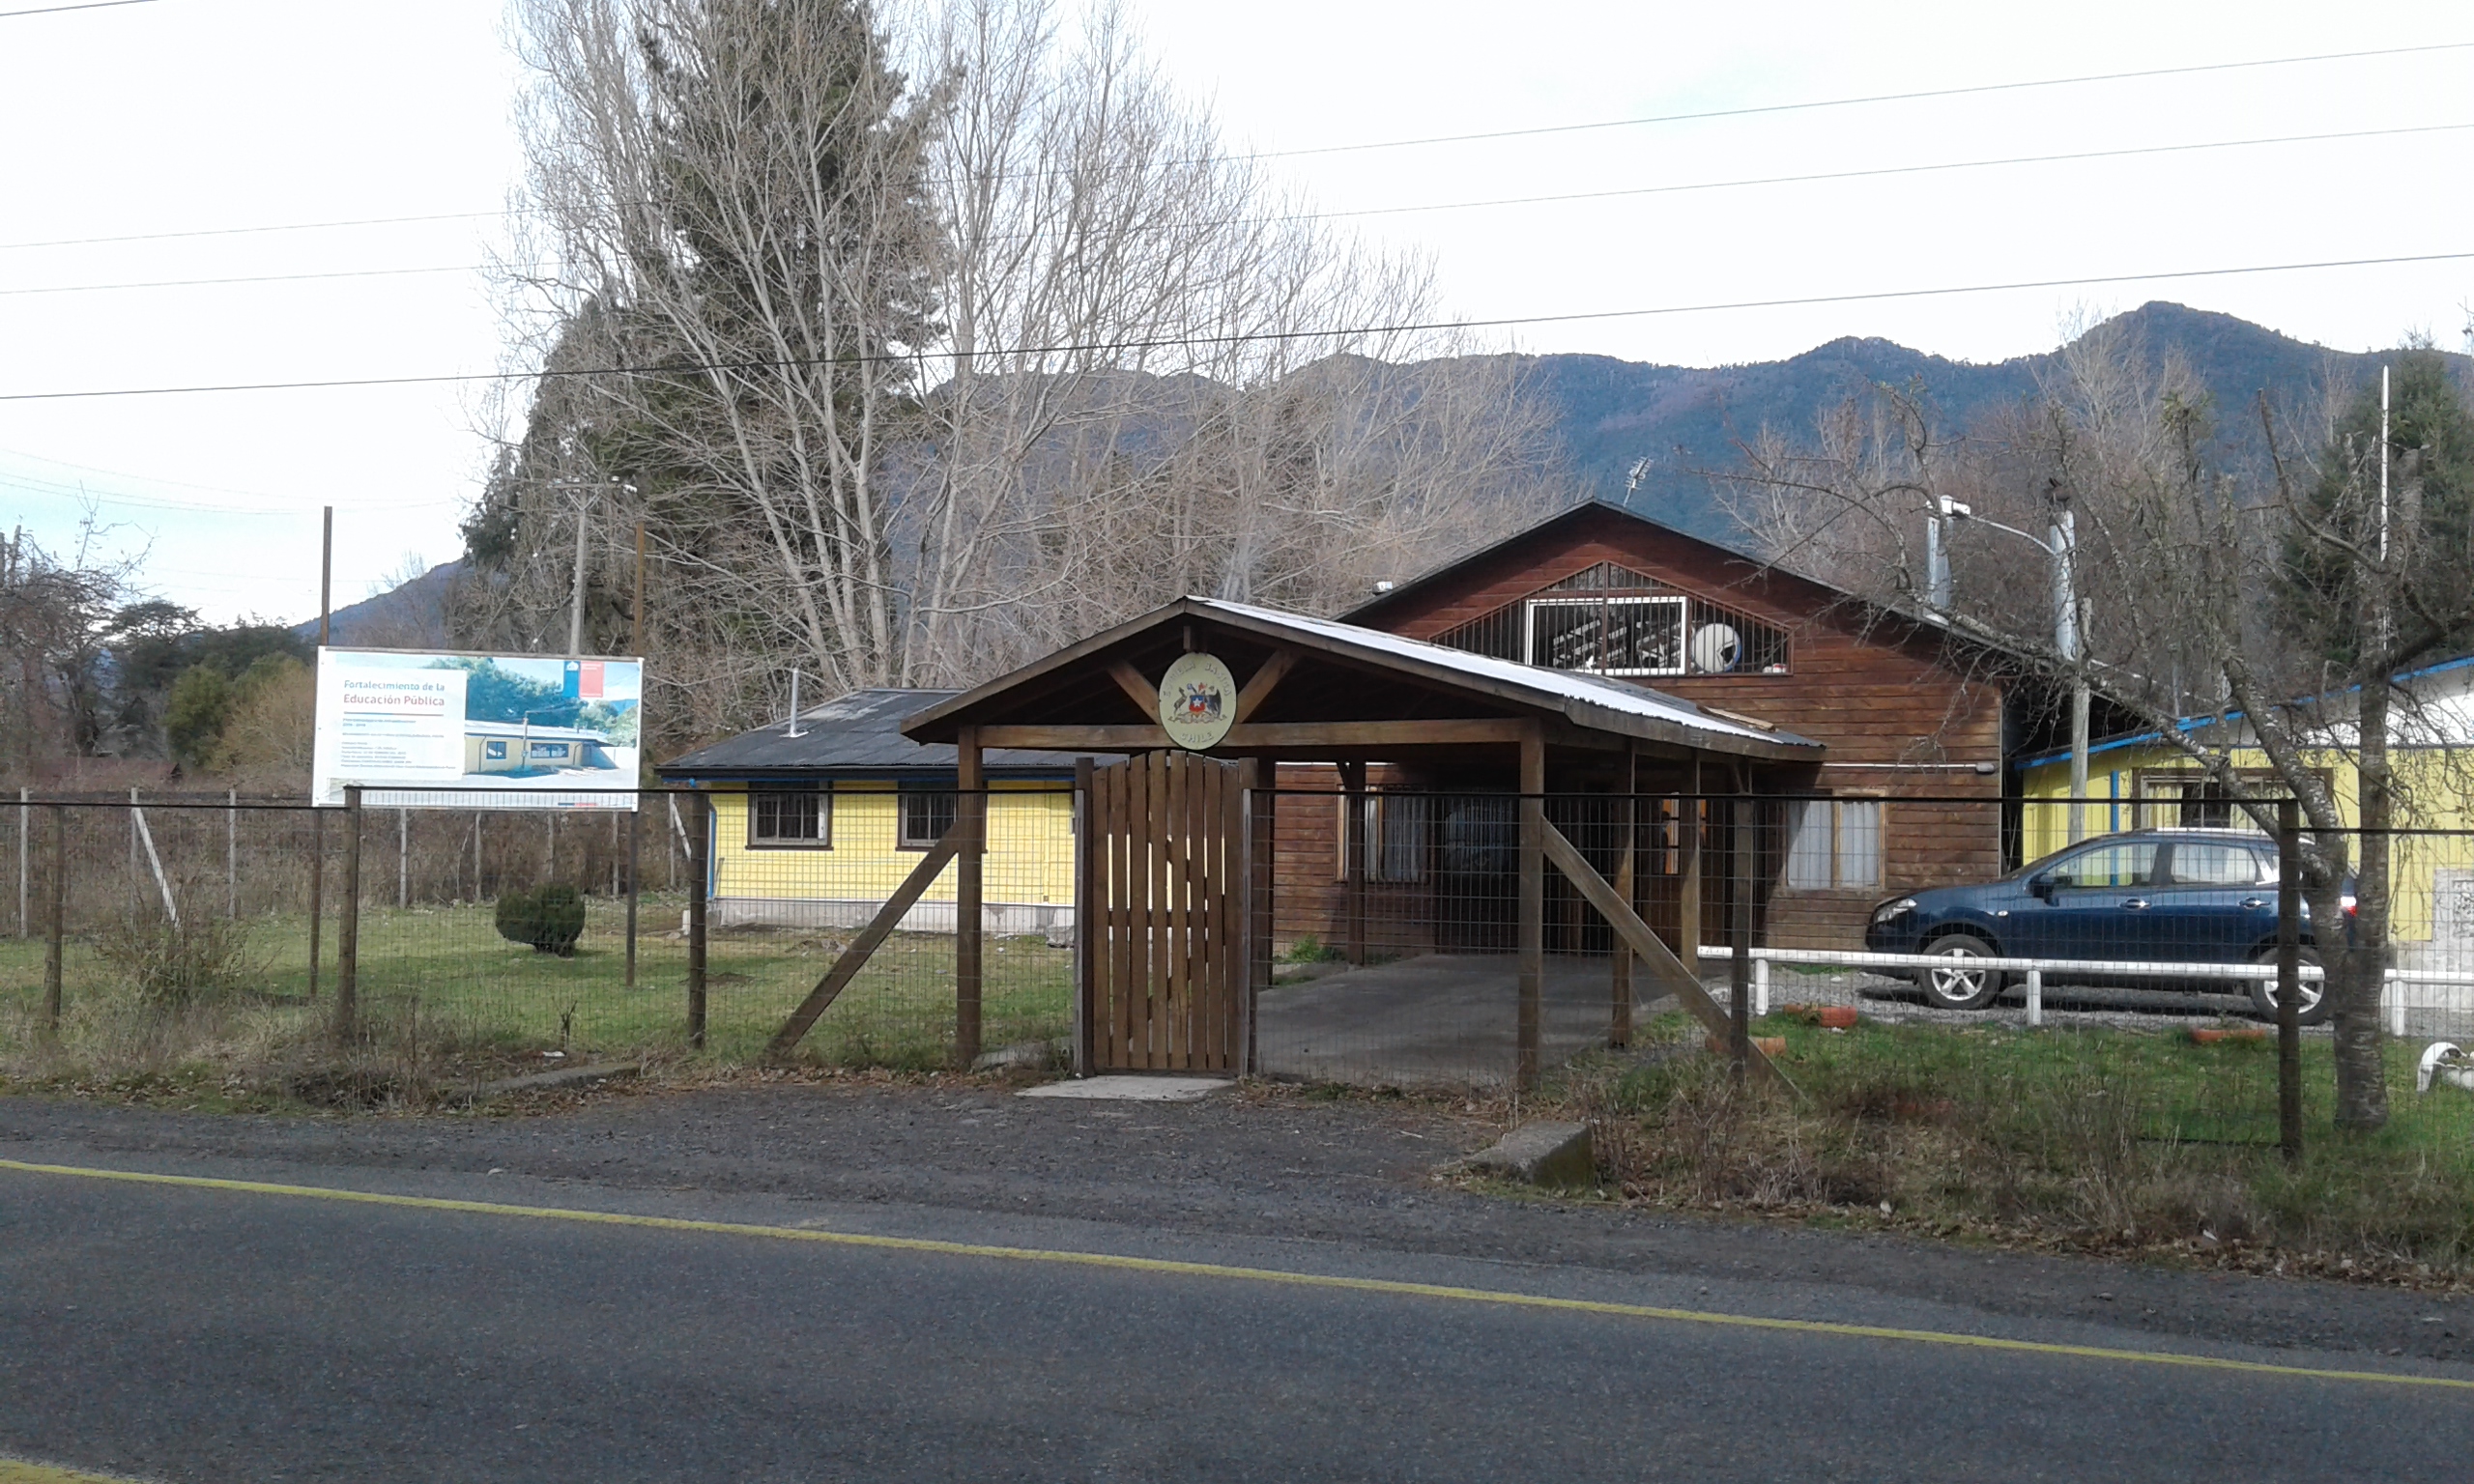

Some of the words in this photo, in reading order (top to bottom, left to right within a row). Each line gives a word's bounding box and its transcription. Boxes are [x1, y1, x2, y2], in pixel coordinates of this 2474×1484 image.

[344, 679, 419, 691] Fortalecimiento
[422, 681, 433, 691] de
[436, 682, 445, 692] la
[343, 694, 401, 704] Educación
[404, 695, 445, 706] Pública
[1181, 731, 1214, 743] CHILE
